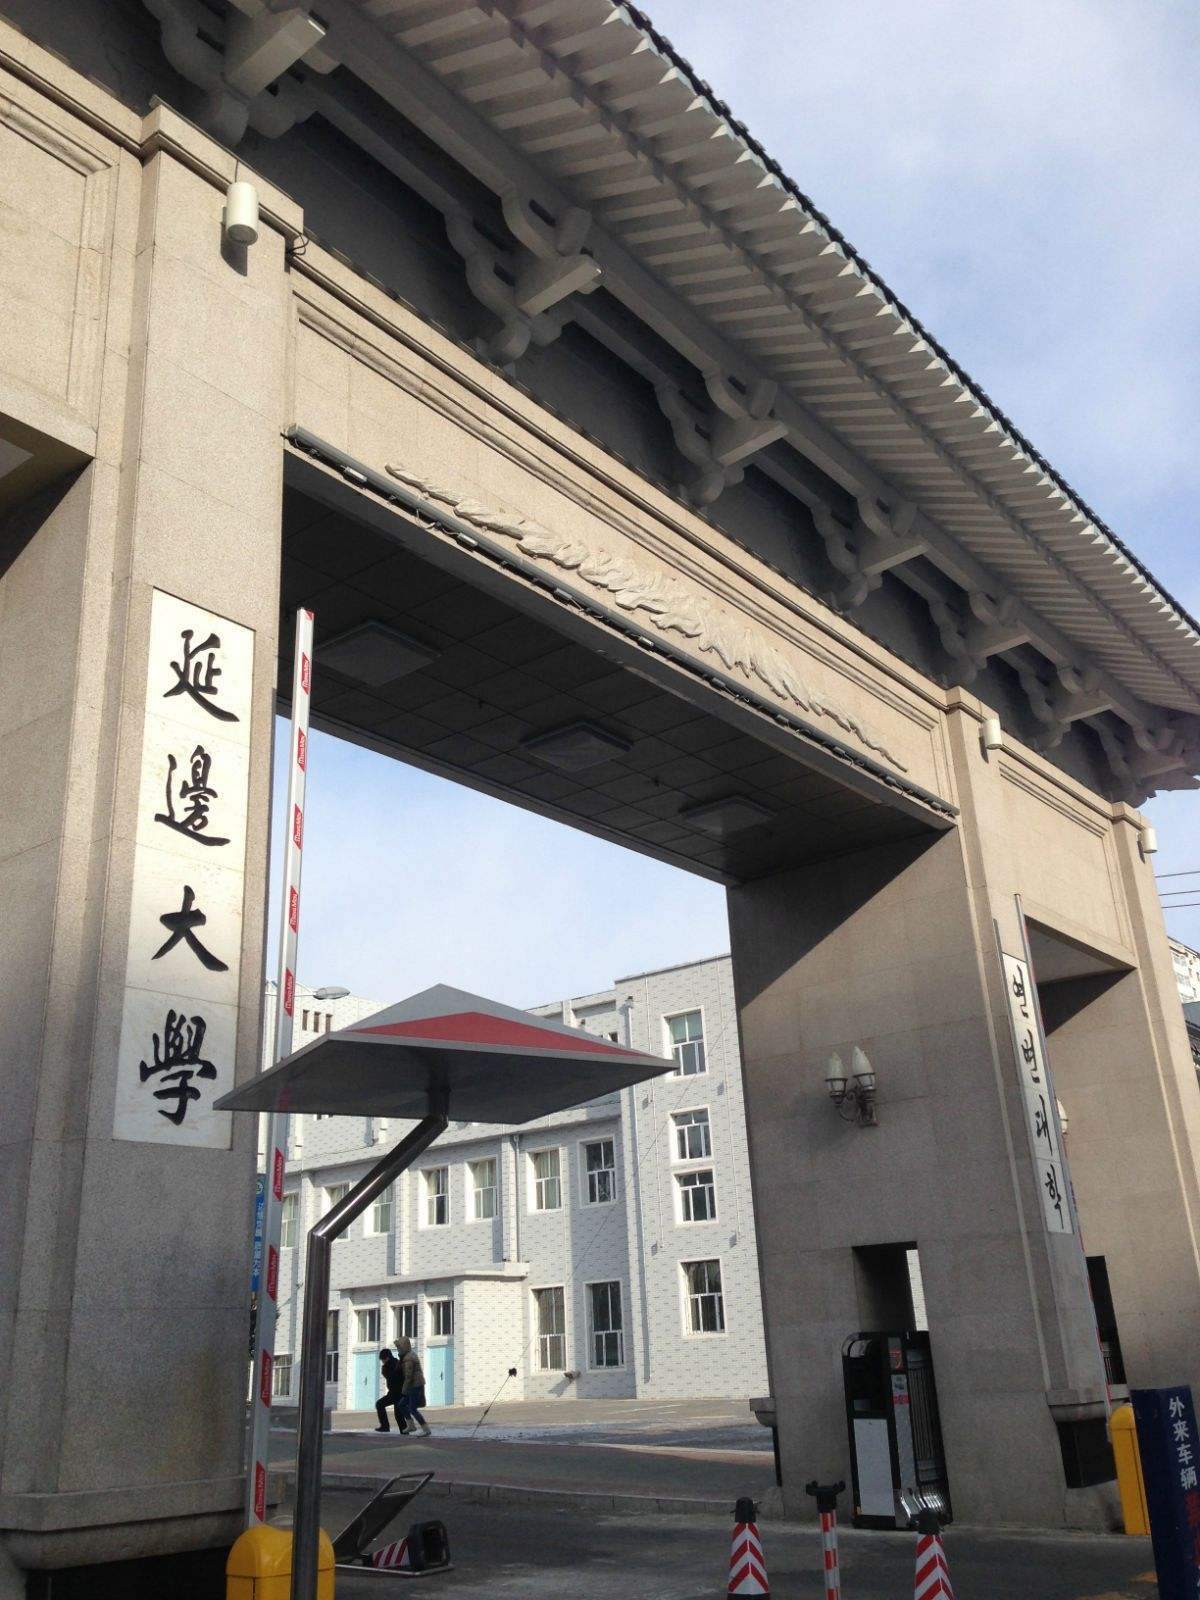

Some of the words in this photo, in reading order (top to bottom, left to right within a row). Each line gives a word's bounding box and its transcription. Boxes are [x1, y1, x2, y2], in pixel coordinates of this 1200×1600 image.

[139, 628, 240, 1126] 延邊大學
[1168, 1396, 1197, 1491] 外来车辆
